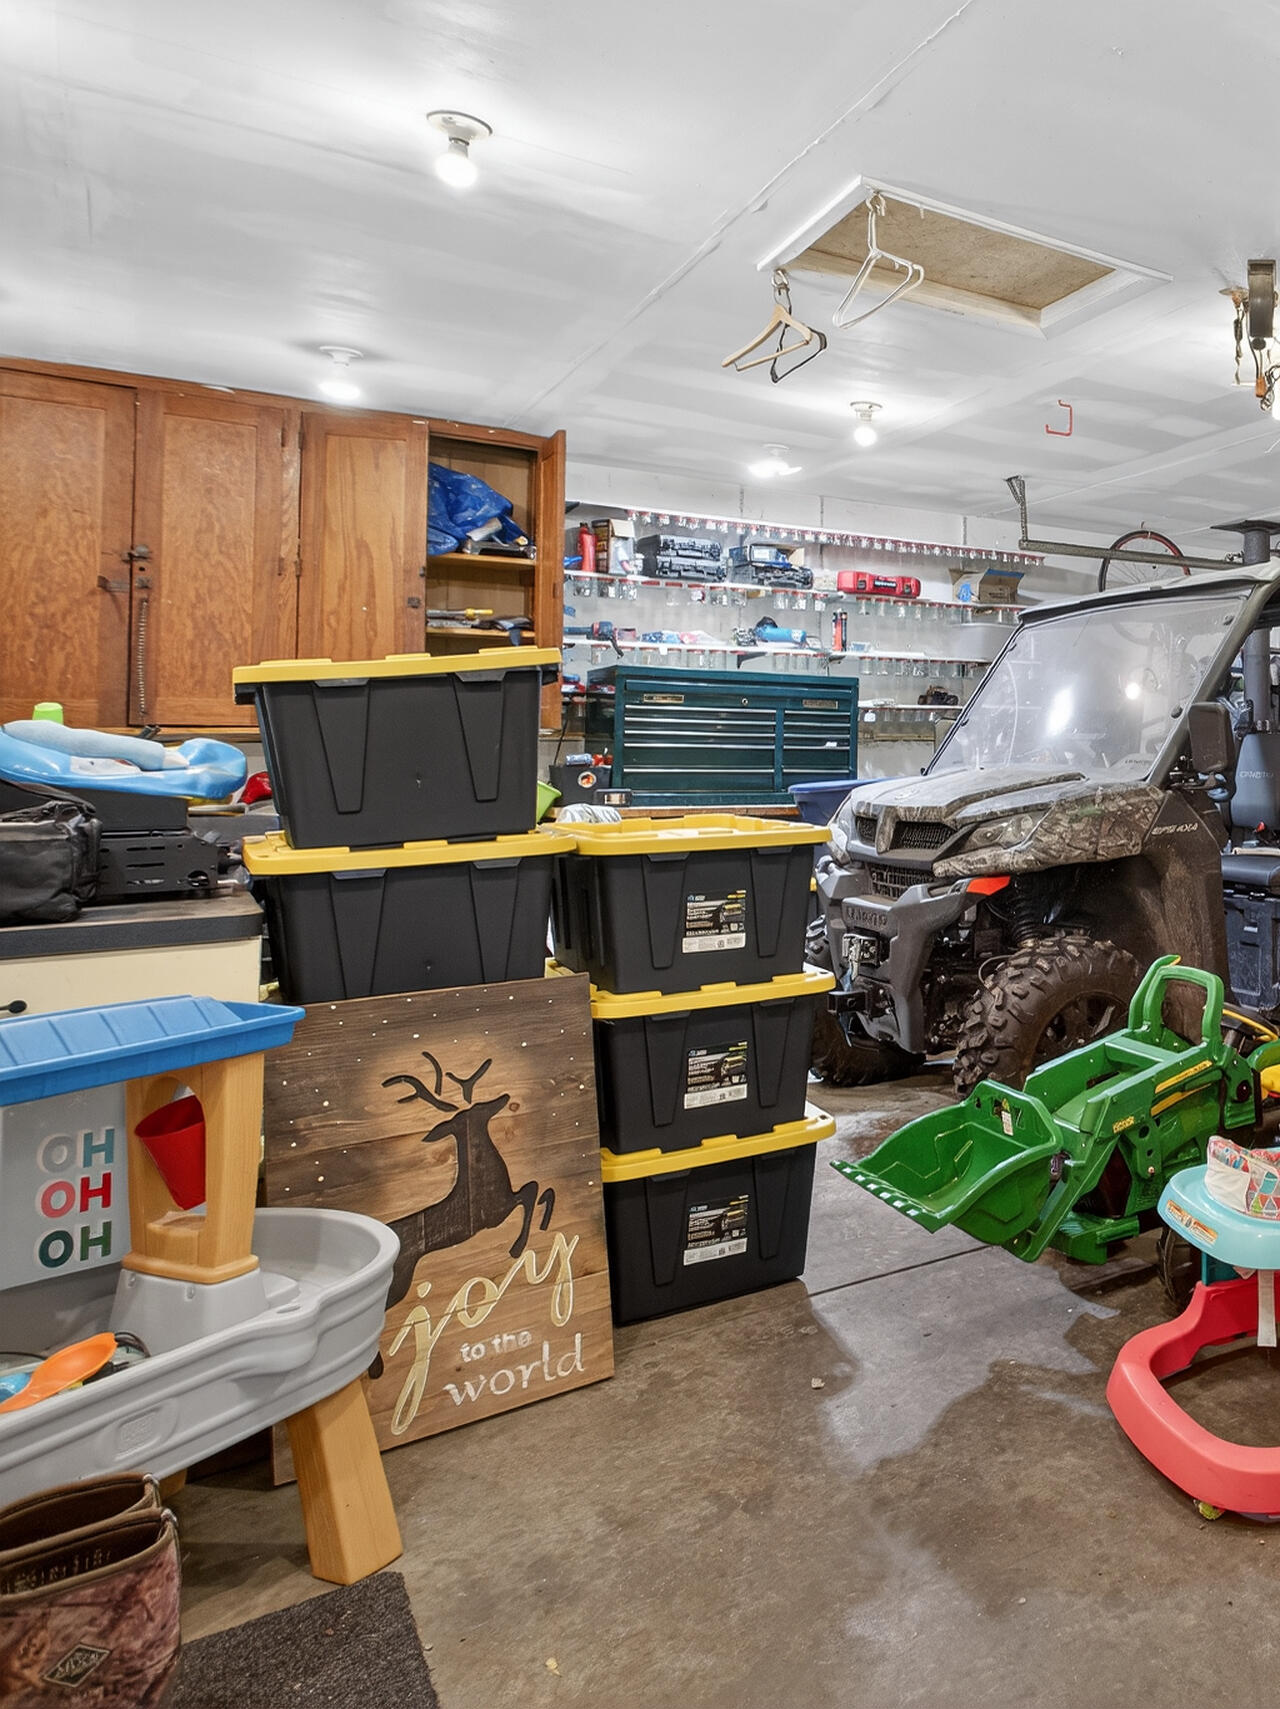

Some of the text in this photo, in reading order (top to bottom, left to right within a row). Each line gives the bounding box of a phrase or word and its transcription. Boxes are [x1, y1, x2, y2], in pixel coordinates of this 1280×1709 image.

[388, 1231, 580, 1435] joy
[443, 1332, 586, 1406] world
[460, 1331, 532, 1362] to the
